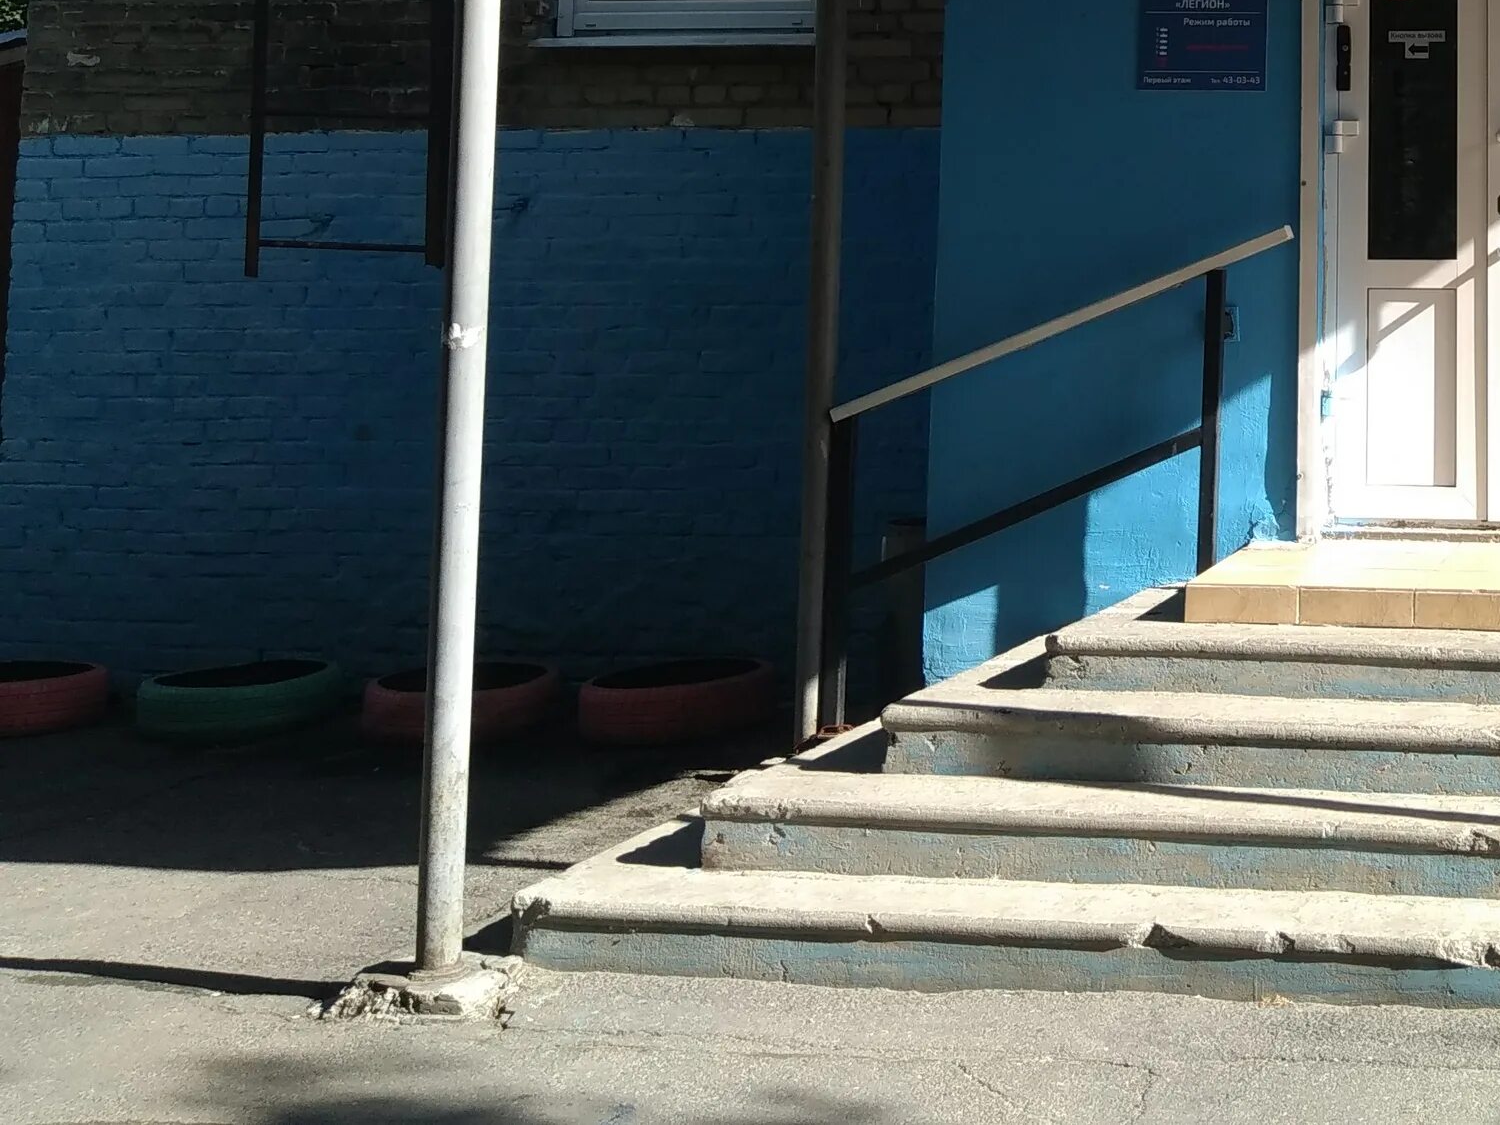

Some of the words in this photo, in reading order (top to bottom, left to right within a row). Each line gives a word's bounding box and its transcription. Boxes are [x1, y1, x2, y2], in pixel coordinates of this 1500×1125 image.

[1175, 0, 1231, 9] «ЛЕГИОН»
[1183, 17, 1215, 26] Режим
[1216, 17, 1251, 27] работы
[1143, 76, 1172, 84] Первый
[1222, 76, 1261, 84] 43-03-43
